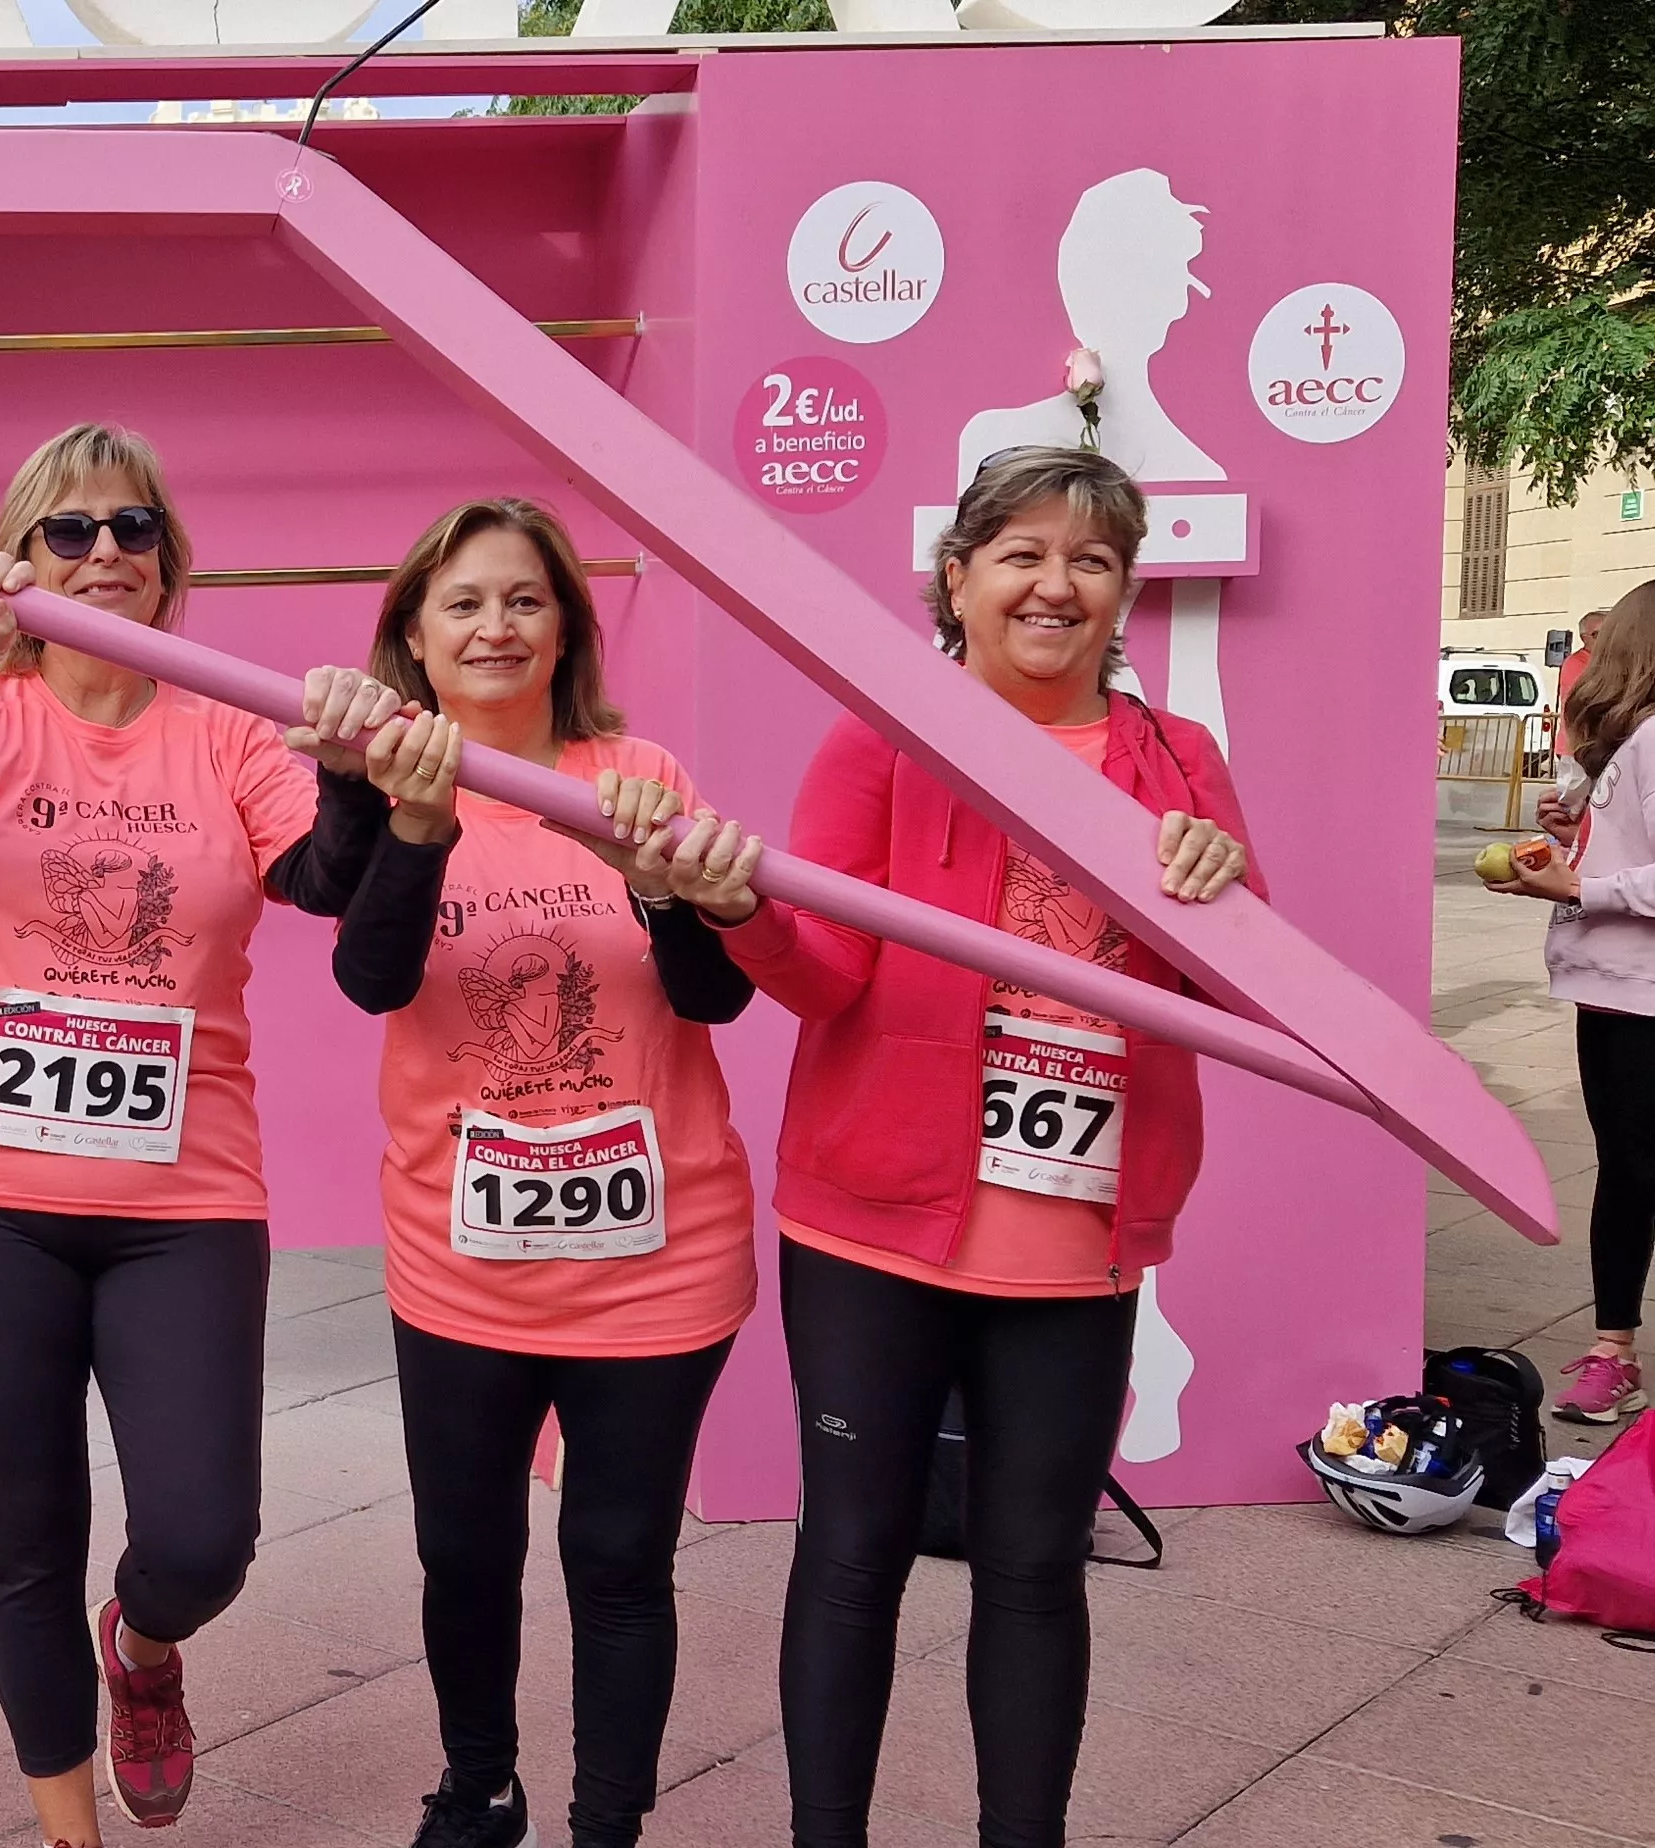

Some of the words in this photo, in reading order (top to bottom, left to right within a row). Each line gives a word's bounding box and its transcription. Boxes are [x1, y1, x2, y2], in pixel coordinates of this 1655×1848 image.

[803, 269, 927, 304] castellar
[1268, 377, 1384, 406] aecc
[1284, 407, 1317, 417] Contra
[1321, 407, 1329, 416] el
[1334, 406, 1366, 416] Cáncer
[755, 438, 767, 453] a
[773, 431, 866, 453] beneficio
[760, 459, 859, 485] aecc
[775, 486, 804, 496] Contra
[807, 485, 814, 494] el
[817, 484, 845, 494] Cáncer
[75, 800, 178, 822] CÁNCER
[127, 822, 199, 834] HUESCA
[485, 883, 593, 913] CÁNCER
[542, 902, 618, 920] HUESCA
[43, 966, 120, 985] QUIÉRETE
[125, 974, 177, 991] MUCHO
[3, 1004, 35, 1015] EDICIÓN
[4, 1021, 77, 1046] CONTRA
[81, 1033, 101, 1049] EL
[105, 1034, 171, 1054] CÁNCER
[66, 1017, 117, 1034] HUESCA
[1030, 1043, 1084, 1064] HUESCA
[983, 1049, 1040, 1074] NTRA
[1045, 1061, 1068, 1079] EL
[1070, 1066, 1129, 1090] CÁNCE
[481, 1077, 555, 1101] QUIÉRETE
[559, 1074, 614, 1093] MUCHO
[982, 1079, 1116, 1157] 667
[474, 1145, 543, 1170] CONTRA
[548, 1157, 568, 1170] EL
[572, 1141, 639, 1167] CÁNCER
[529, 1141, 582, 1156] HUESCA
[471, 1167, 646, 1227] 1290
